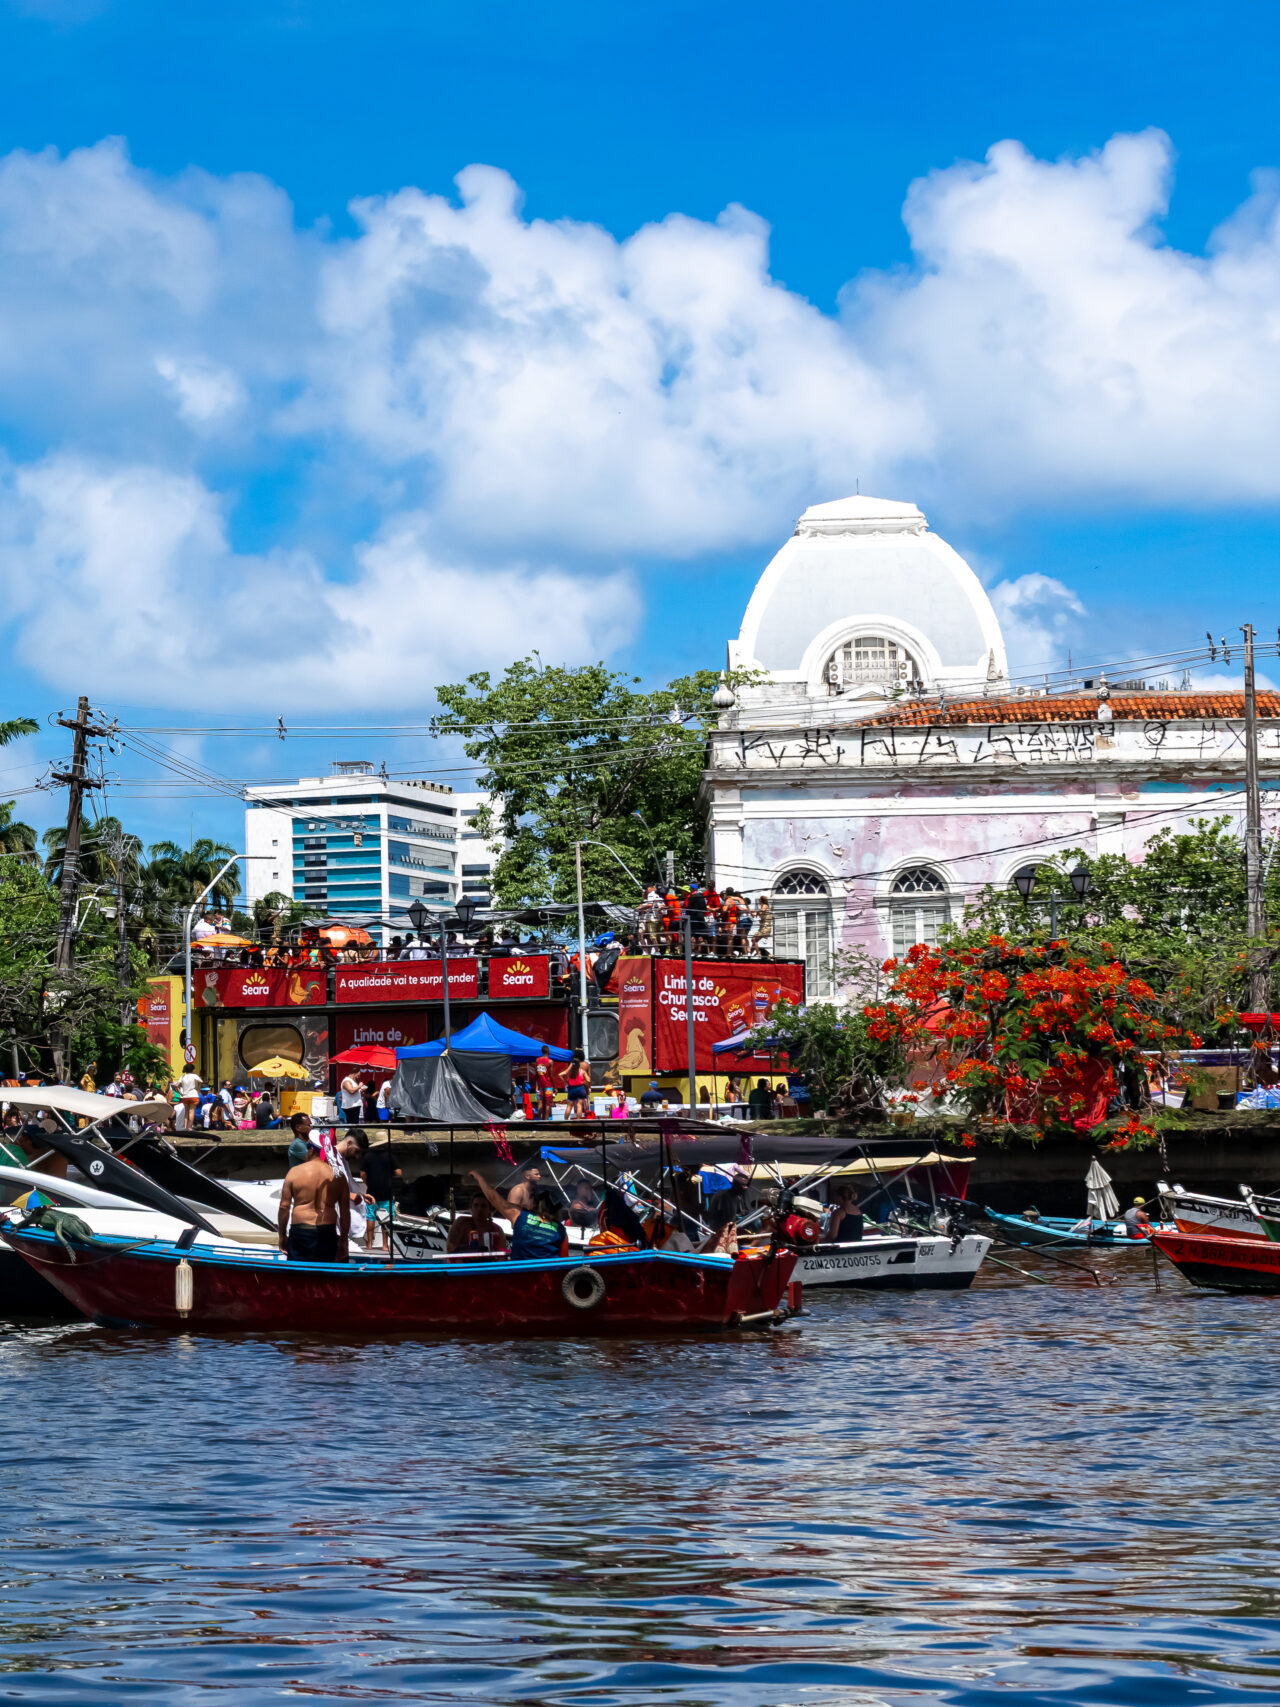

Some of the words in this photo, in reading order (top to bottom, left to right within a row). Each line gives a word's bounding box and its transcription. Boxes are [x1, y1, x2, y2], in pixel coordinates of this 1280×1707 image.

[340, 979, 347, 988] A
[348, 976, 392, 989] qualidade
[393, 975, 407, 985] vai
[409, 974, 418, 984] te
[419, 973, 475, 986] surprender
[502, 974, 534, 985] Seara
[698, 976, 714, 991] de
[242, 984, 270, 996] Seara
[623, 984, 646, 993] Seara
[659, 990, 720, 1007] Churasco
[670, 1006, 709, 1022] Sera.
[354, 1028, 384, 1042] Linha
[386, 1027, 402, 1041] de
